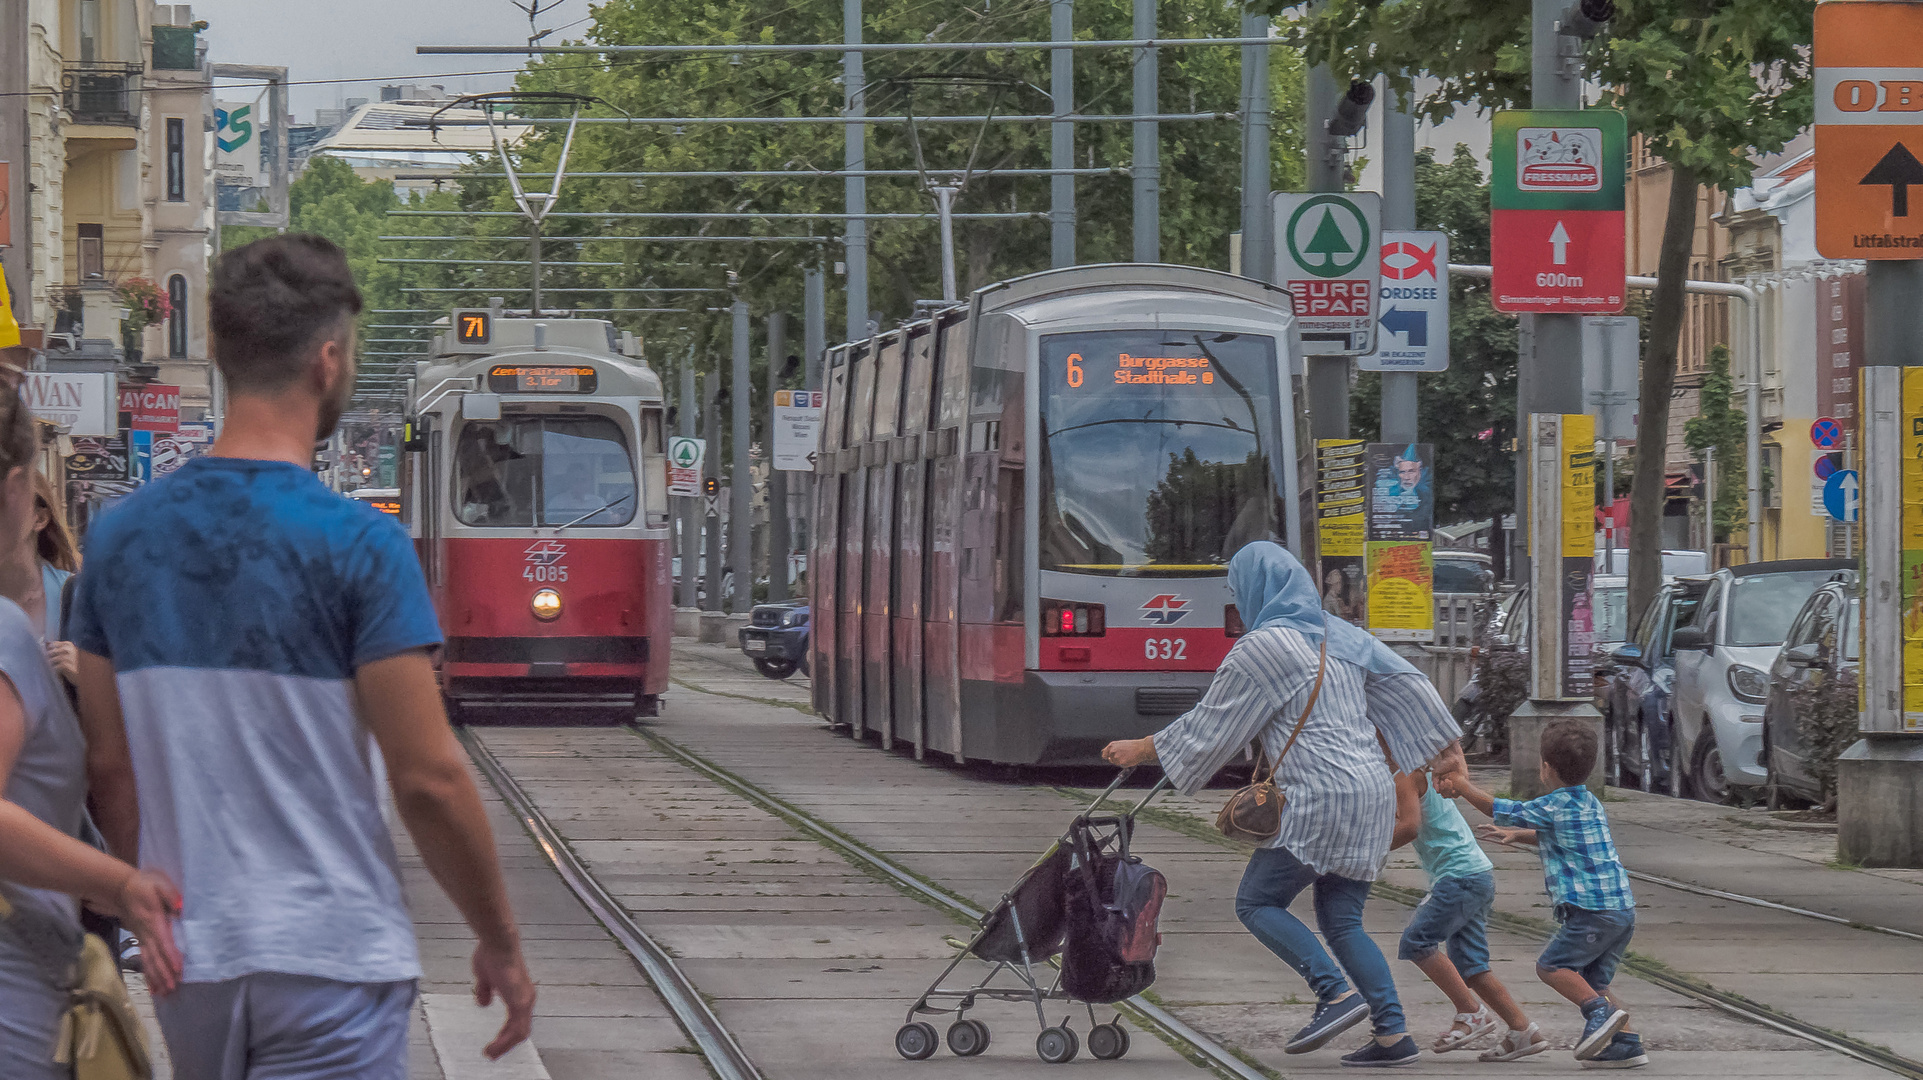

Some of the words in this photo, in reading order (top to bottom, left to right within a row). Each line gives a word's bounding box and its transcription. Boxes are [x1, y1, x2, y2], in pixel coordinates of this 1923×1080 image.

[1524, 172, 1597, 182] FRESSNAPF
[1536, 273, 1583, 287] 600m
[1289, 283, 1369, 298] EURO
[1380, 287, 1437, 300] ORDSEE
[1295, 299, 1369, 314] SPAR
[463, 317, 484, 338] 71
[1119, 353, 1209, 371] Burggasse
[1066, 353, 1084, 388] 6
[1114, 370, 1197, 385] Stadthalle
[121, 392, 179, 410] AYCAN
[522, 566, 569, 582] 4085
[1144, 638, 1187, 660] 632
